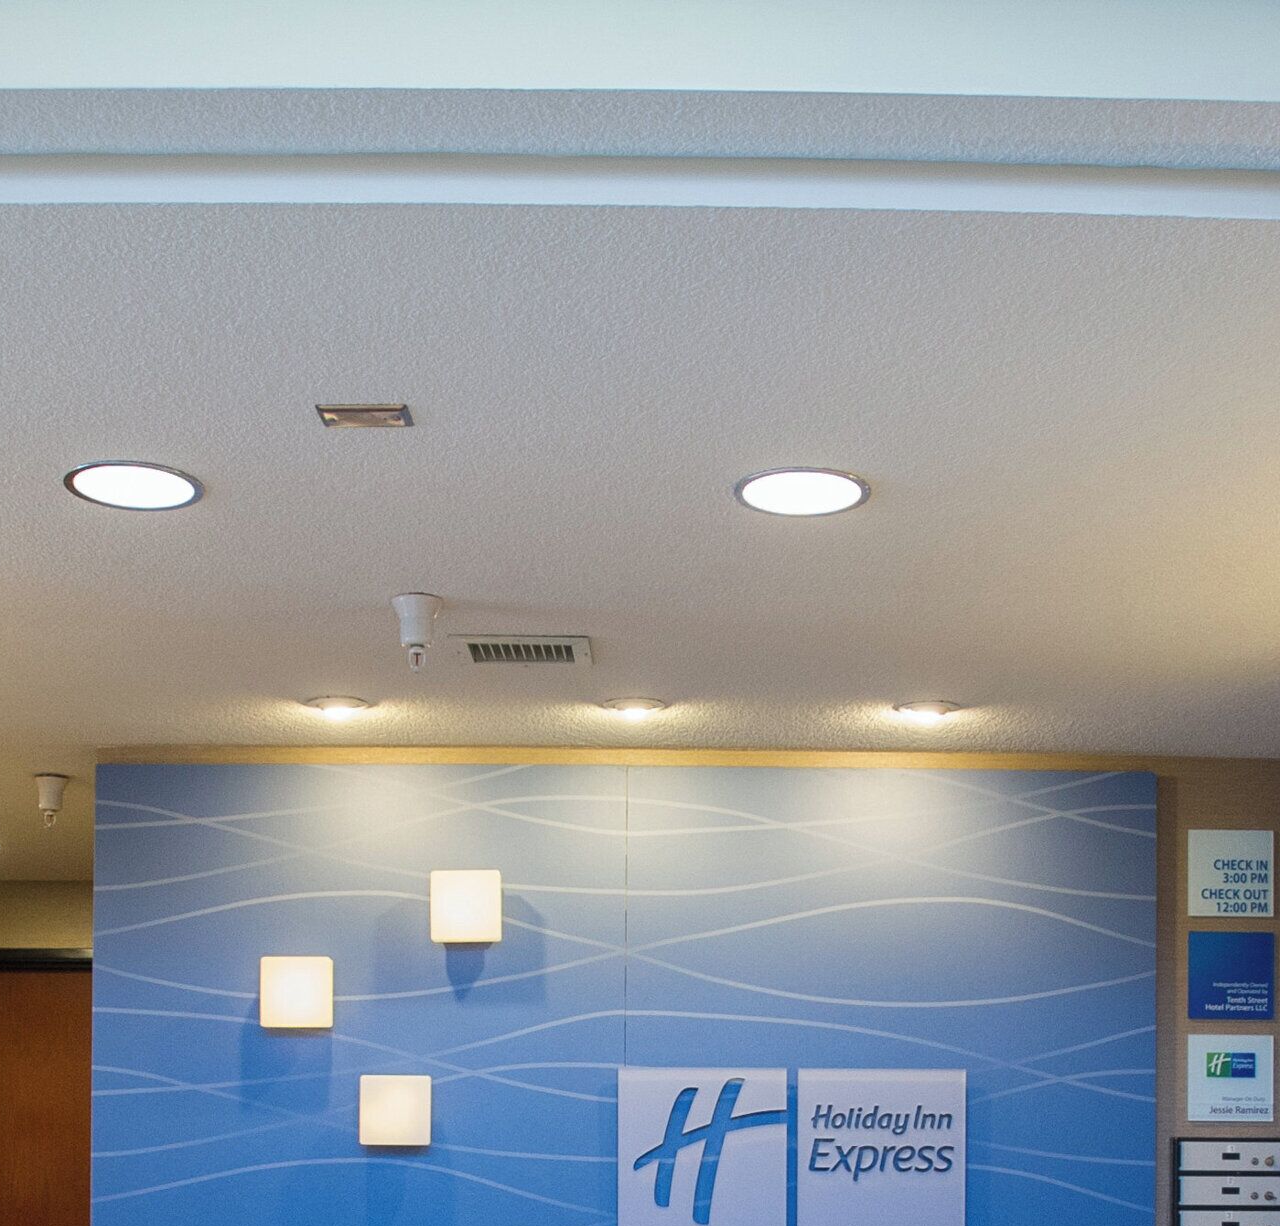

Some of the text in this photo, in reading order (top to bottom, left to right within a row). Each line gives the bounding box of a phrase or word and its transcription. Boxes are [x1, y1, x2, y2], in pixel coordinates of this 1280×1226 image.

[1213, 859, 1269, 871] CHECK IN
[1223, 873, 1269, 884] 3:00 PM
[1201, 888, 1269, 900] CHECK OUT
[1216, 902, 1269, 913] 12:00 PM
[1226, 996, 1269, 1004] Tenth Street
[1205, 1003, 1269, 1012] Hotel Partners LLC
[1209, 1105, 1270, 1115] Jessie Ramirez
[810, 1104, 953, 1136] Holiday Inn
[808, 1137, 955, 1182] Express
